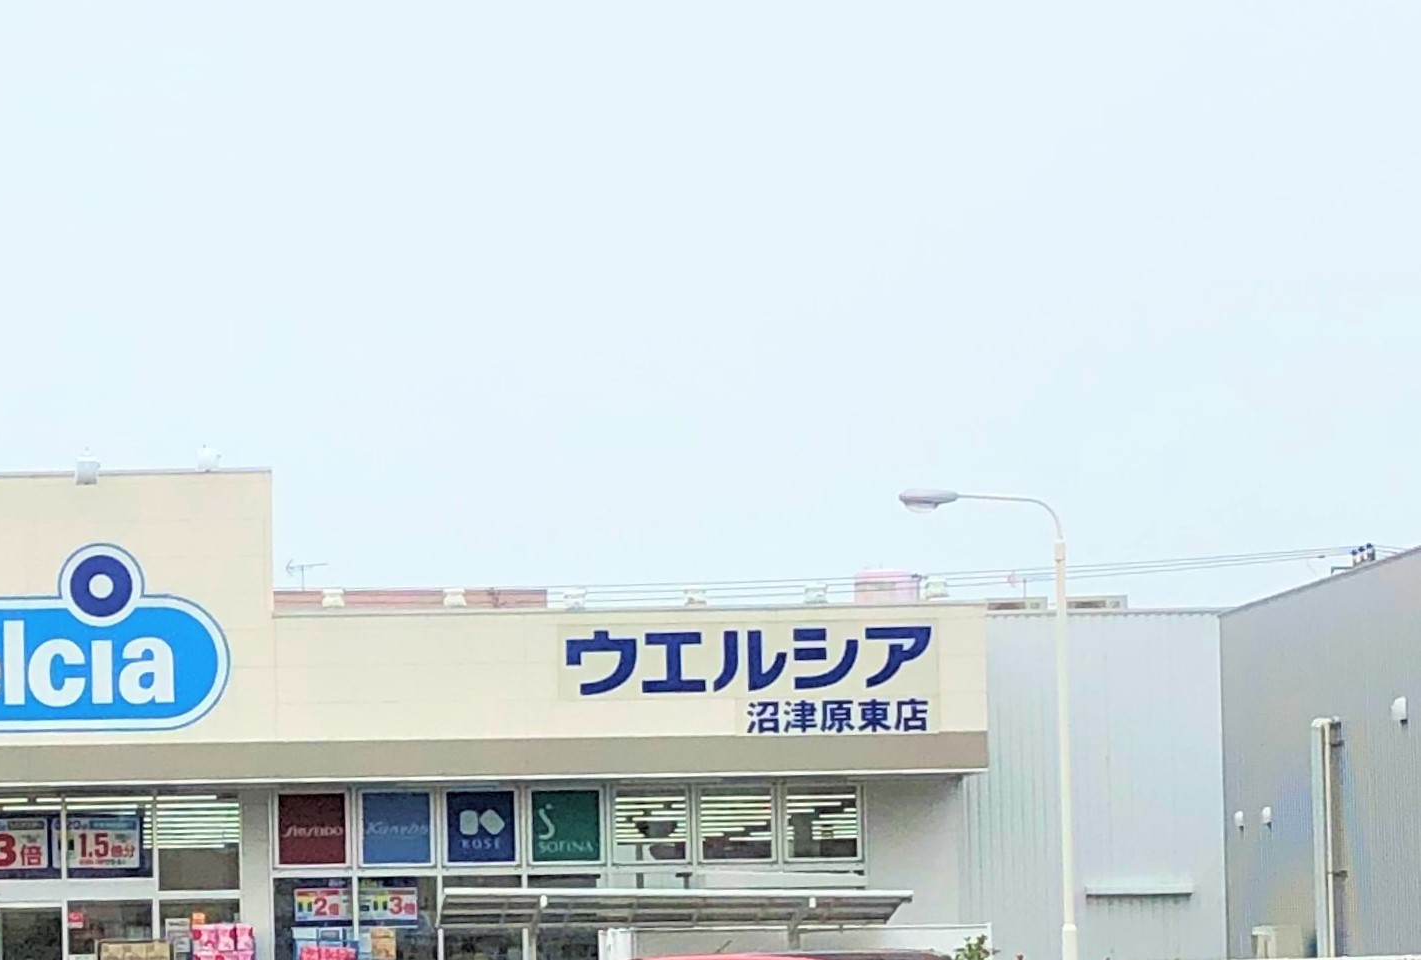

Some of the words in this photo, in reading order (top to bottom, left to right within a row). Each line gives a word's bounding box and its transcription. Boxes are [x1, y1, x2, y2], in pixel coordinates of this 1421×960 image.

[565, 625, 933, 696] ウエルシア
[746, 699, 929, 734] 沼津原東店
